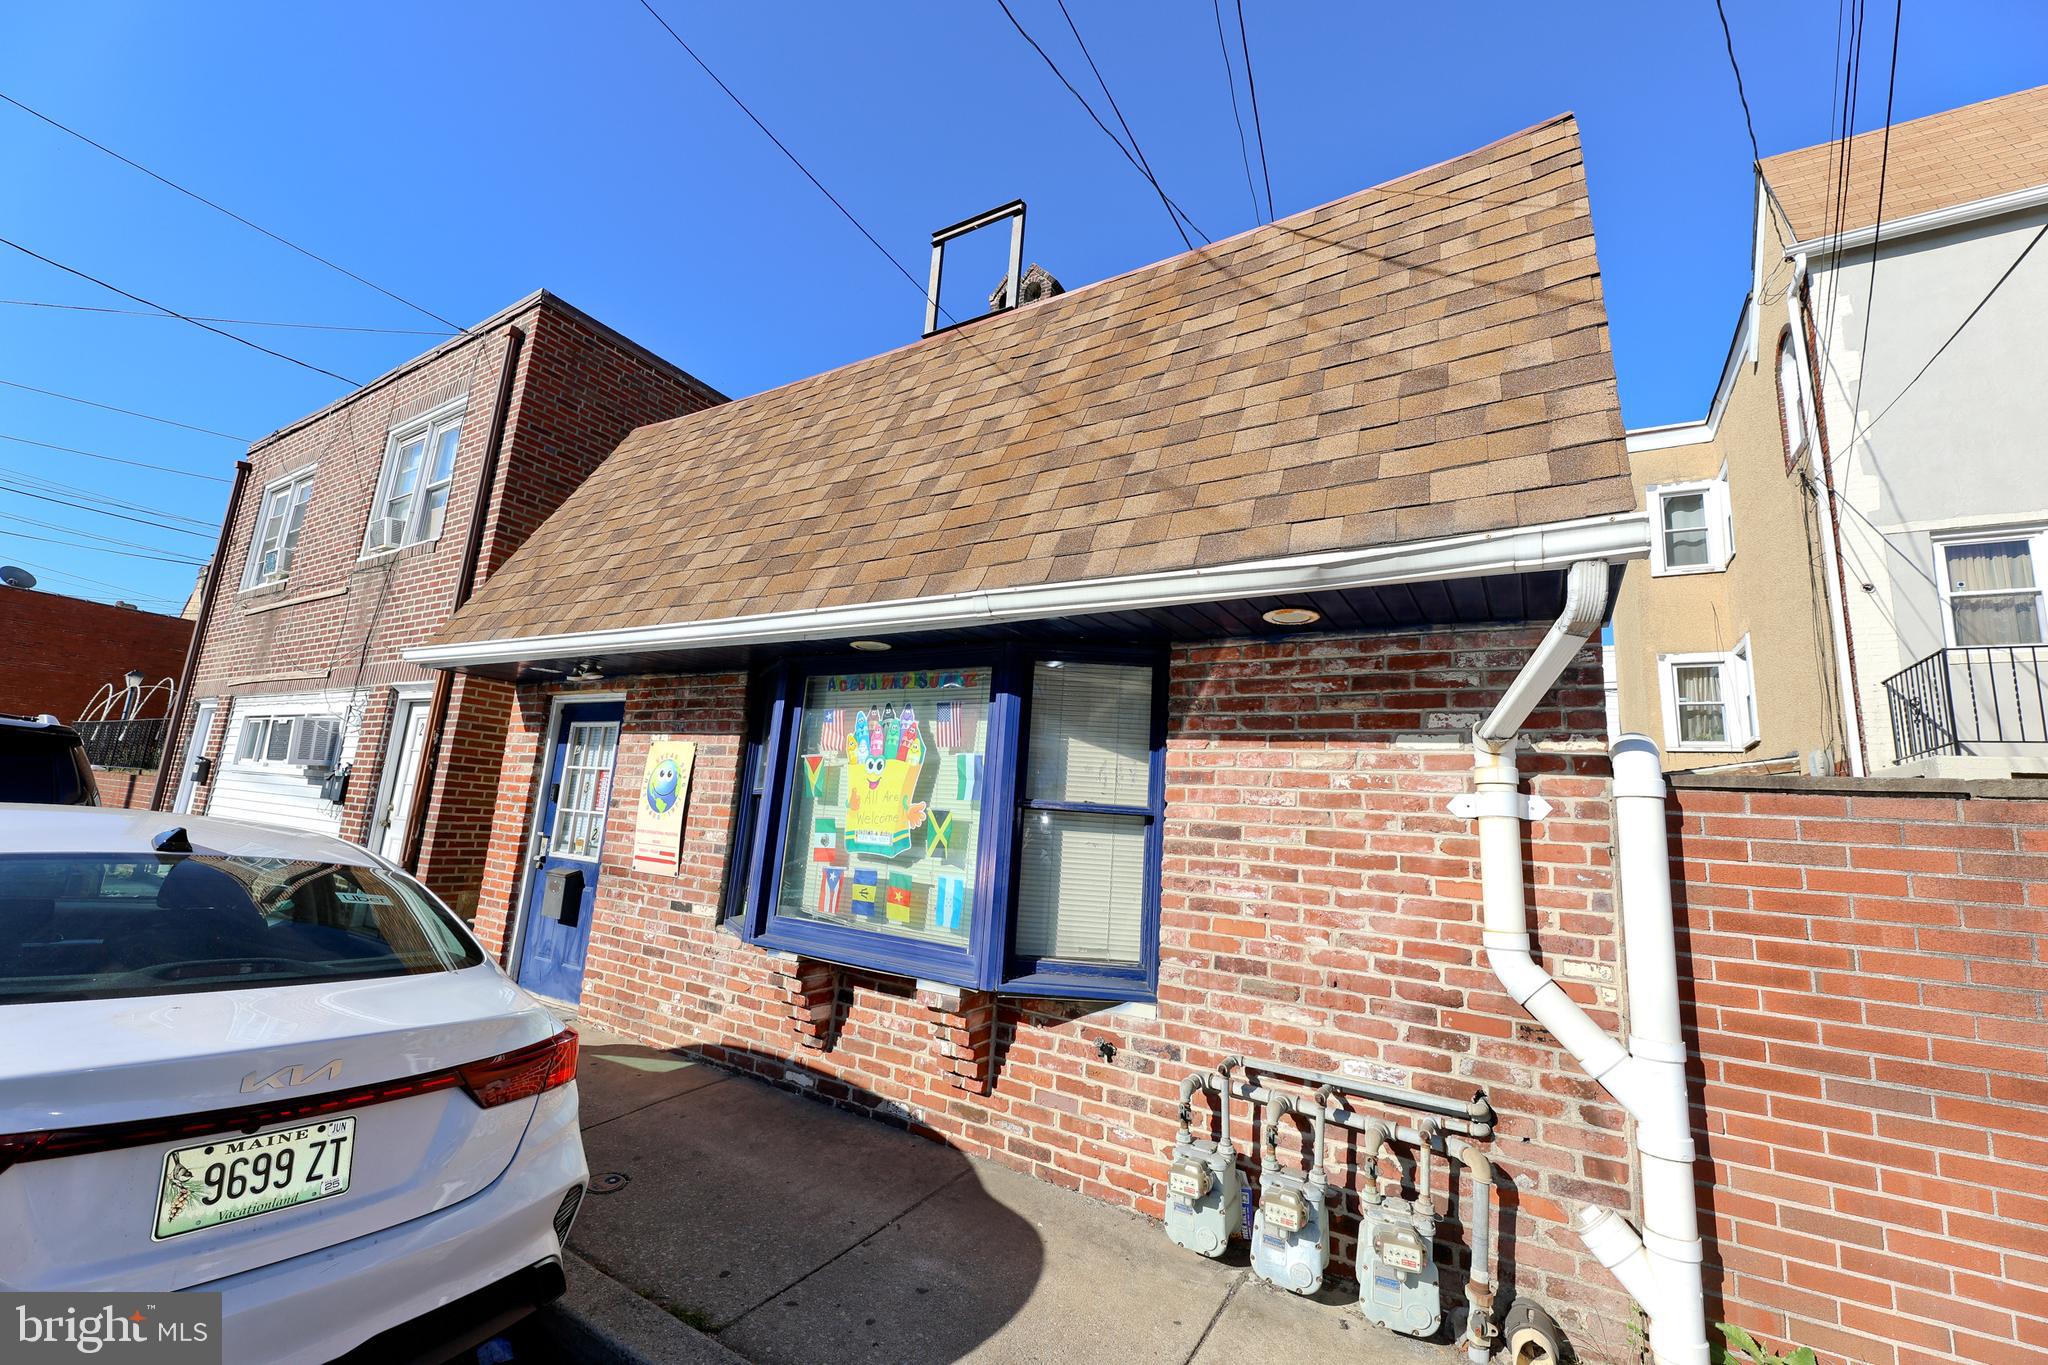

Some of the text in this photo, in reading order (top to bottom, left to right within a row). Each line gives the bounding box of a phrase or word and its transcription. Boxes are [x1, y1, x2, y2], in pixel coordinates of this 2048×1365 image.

[863, 789, 878, 805] All
[583, 781, 590, 794] 3
[591, 828, 598, 841] 2
[856, 811, 900, 825] Welcome
[331, 1121, 347, 1134] JUN
[224, 1128, 309, 1155] MAINE
[201, 1136, 347, 1206] 9699 ZT
[324, 1180, 340, 1191] 25
[218, 1192, 299, 1221] Vacationland
